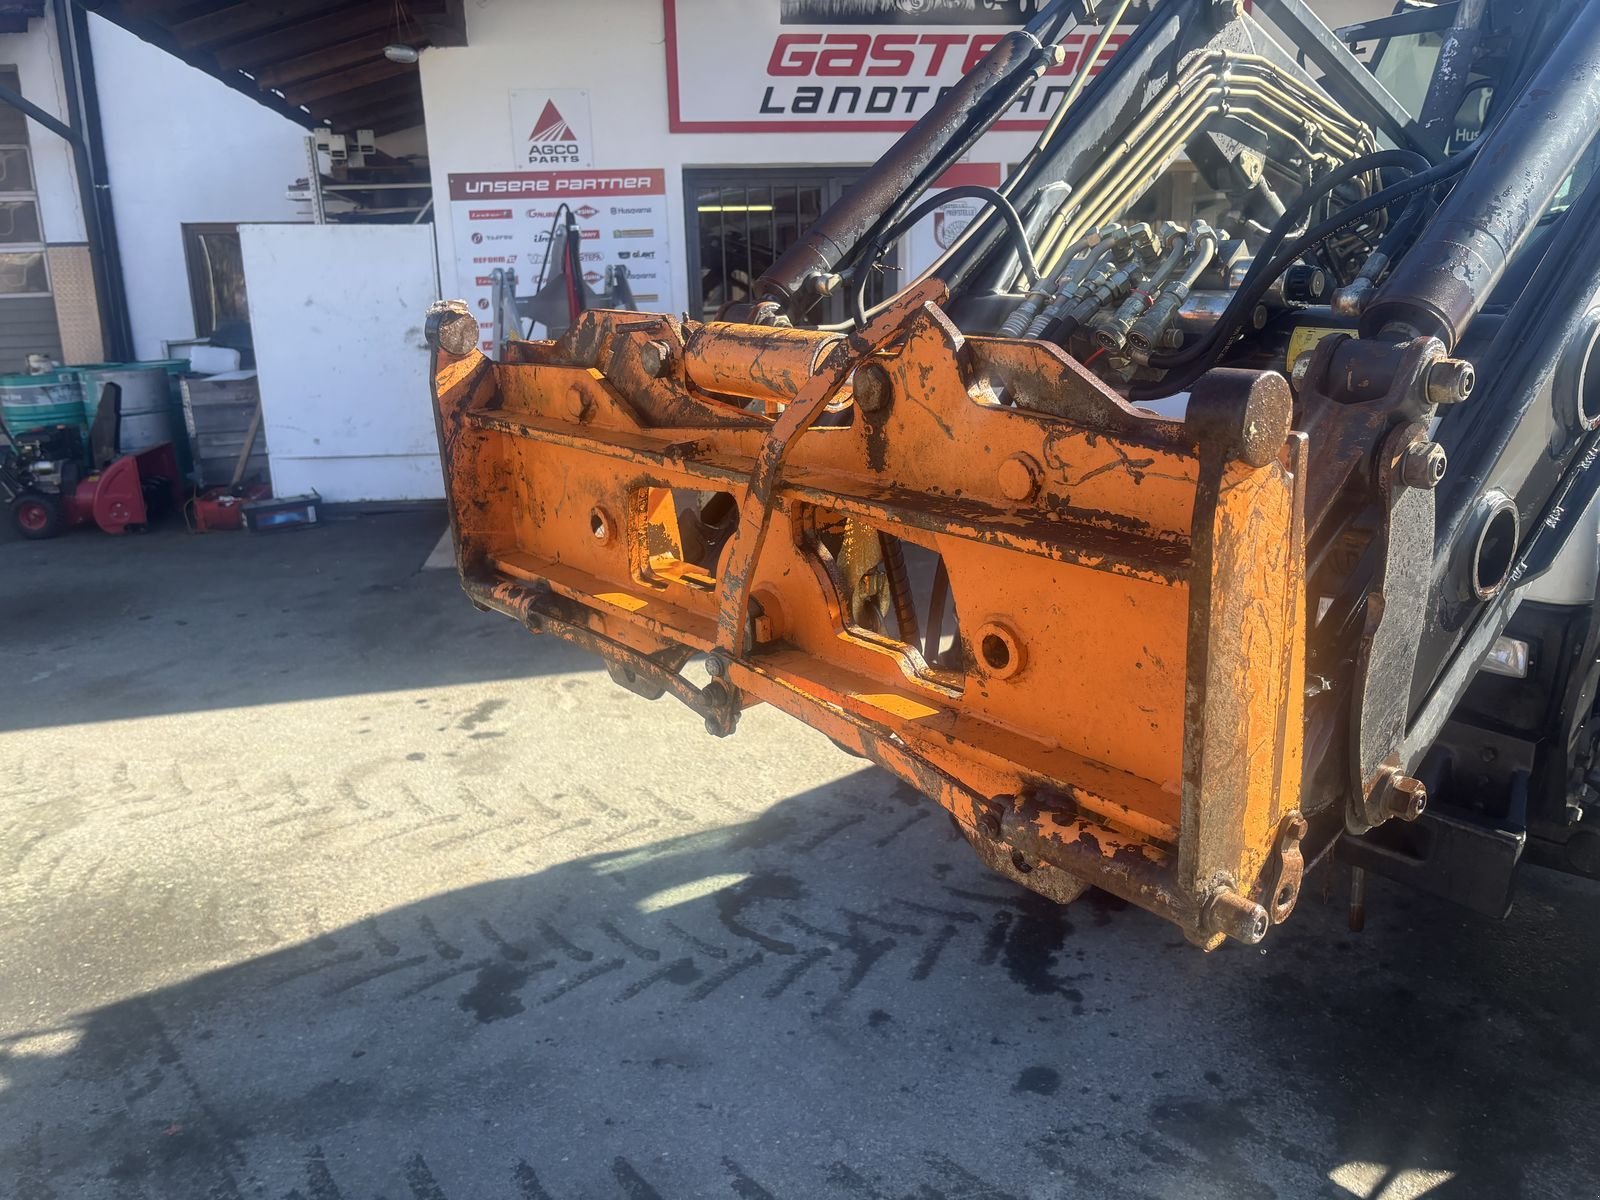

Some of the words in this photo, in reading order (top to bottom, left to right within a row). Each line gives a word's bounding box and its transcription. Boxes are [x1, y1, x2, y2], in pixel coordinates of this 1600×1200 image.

[529, 144, 578, 155] AGCO
[466, 180, 549, 193] UNSERE
[556, 177, 651, 191] PARTNER
